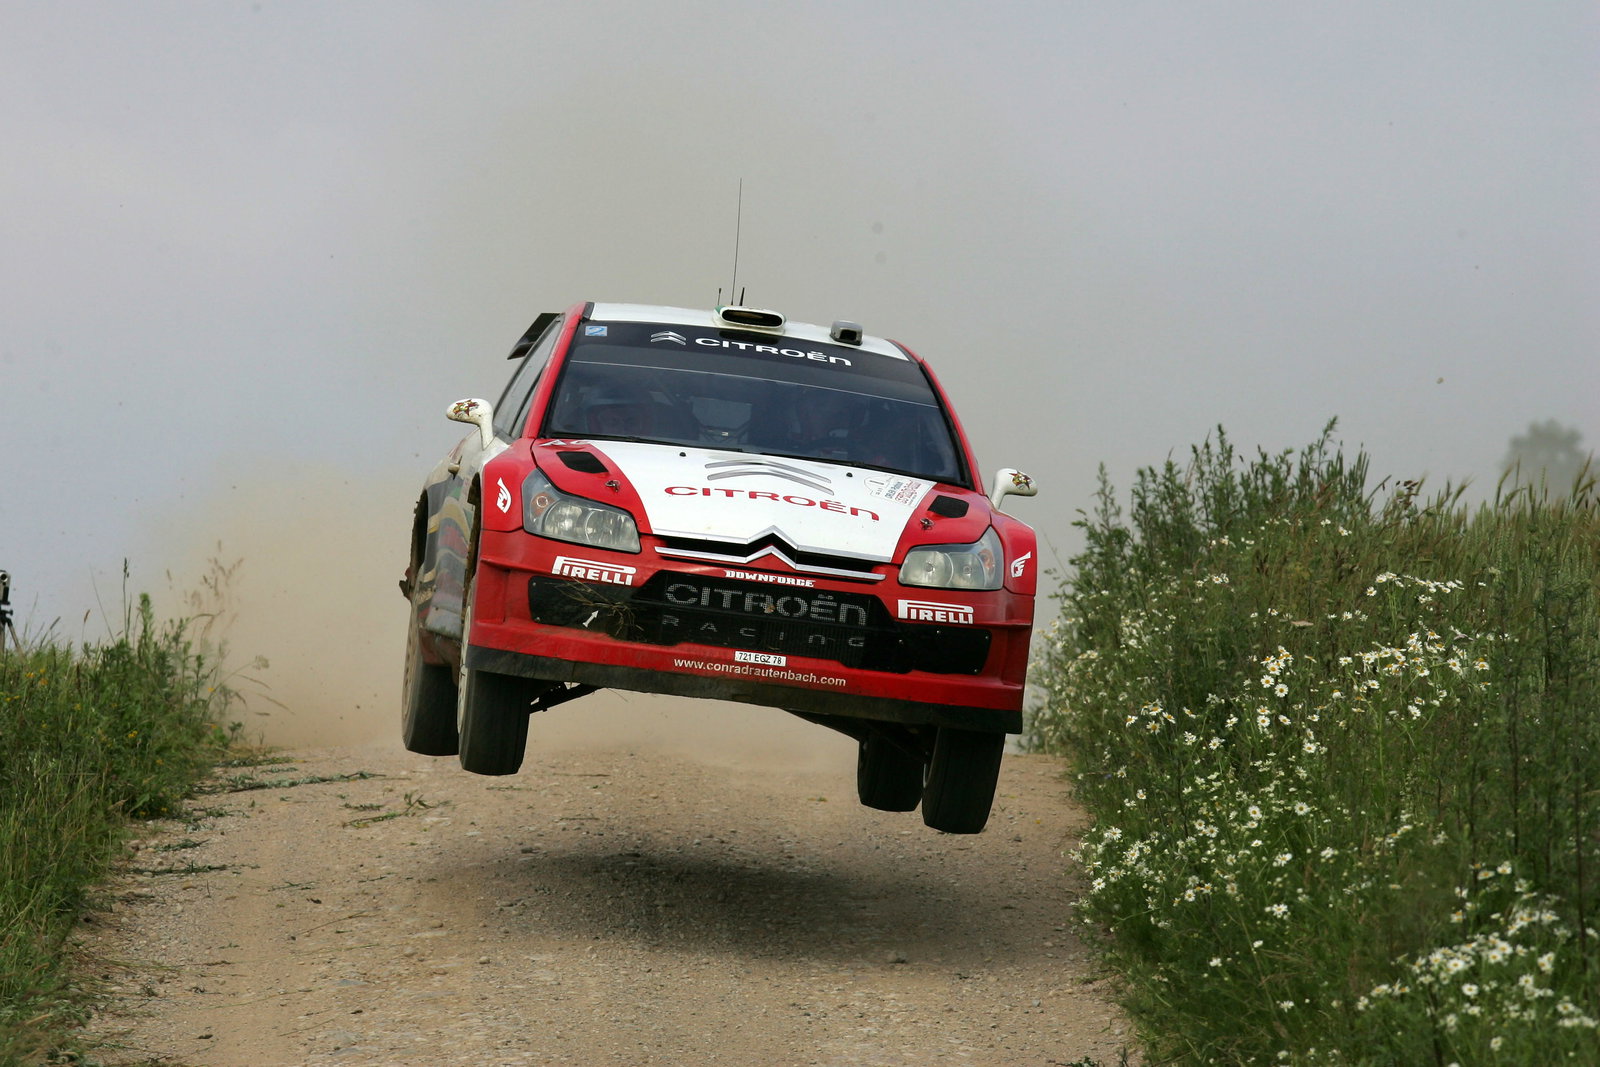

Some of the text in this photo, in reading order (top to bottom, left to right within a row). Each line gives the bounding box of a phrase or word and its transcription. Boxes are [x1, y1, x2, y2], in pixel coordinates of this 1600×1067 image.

[695, 337, 852, 367] CITROËN
[664, 486, 880, 522] CITROËN
[551, 555, 637, 586] PIRELLI
[665, 583, 867, 626] CITROËN
[897, 599, 974, 625] PIRELLI
[661, 614, 865, 648] RACING
[674, 657, 847, 687] www.conradrautenbach.com
[738, 652, 782, 665] 721 EGZ 78
